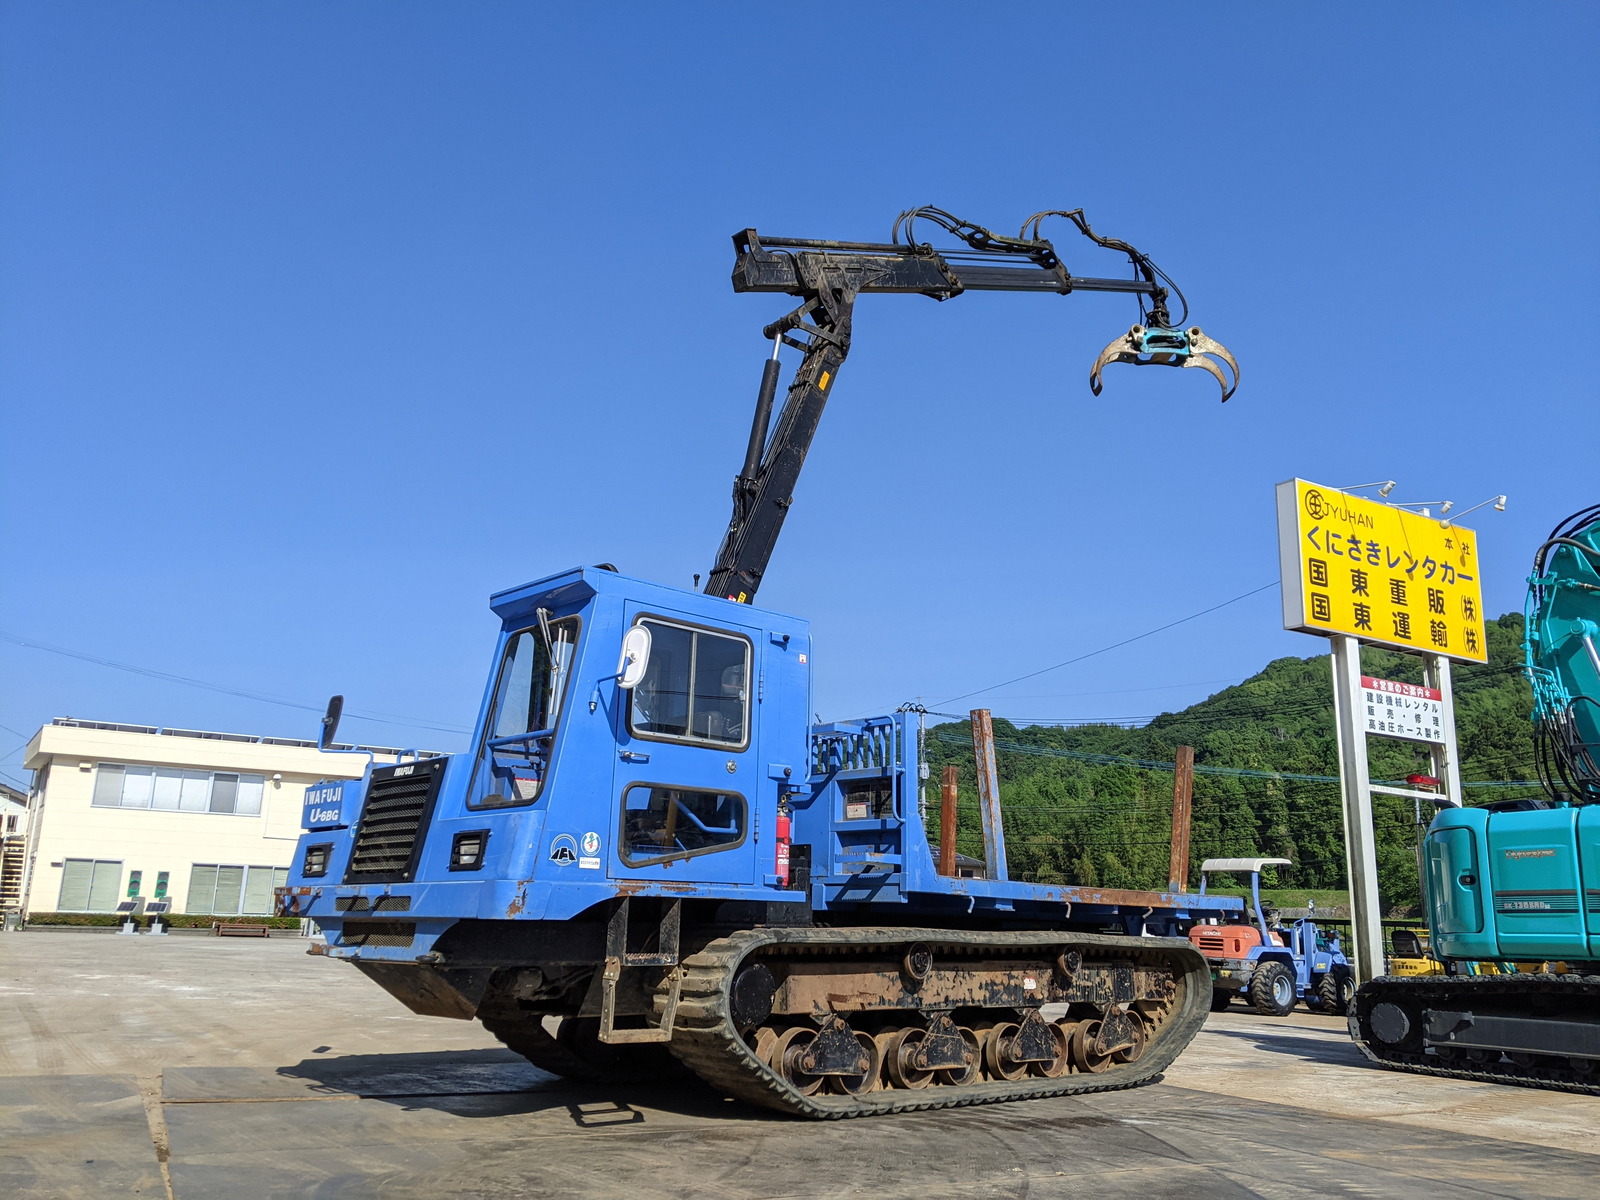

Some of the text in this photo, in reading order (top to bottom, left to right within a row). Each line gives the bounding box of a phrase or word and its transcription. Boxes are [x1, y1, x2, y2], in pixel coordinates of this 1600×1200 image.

[1322, 502, 1373, 529] JYUHAN
[1307, 526, 1473, 585] くにさきレンタカー
[1444, 537, 1471, 556] 本社
[304, 786, 342, 806] IWAFUJI
[309, 808, 339, 823] U-6BG
